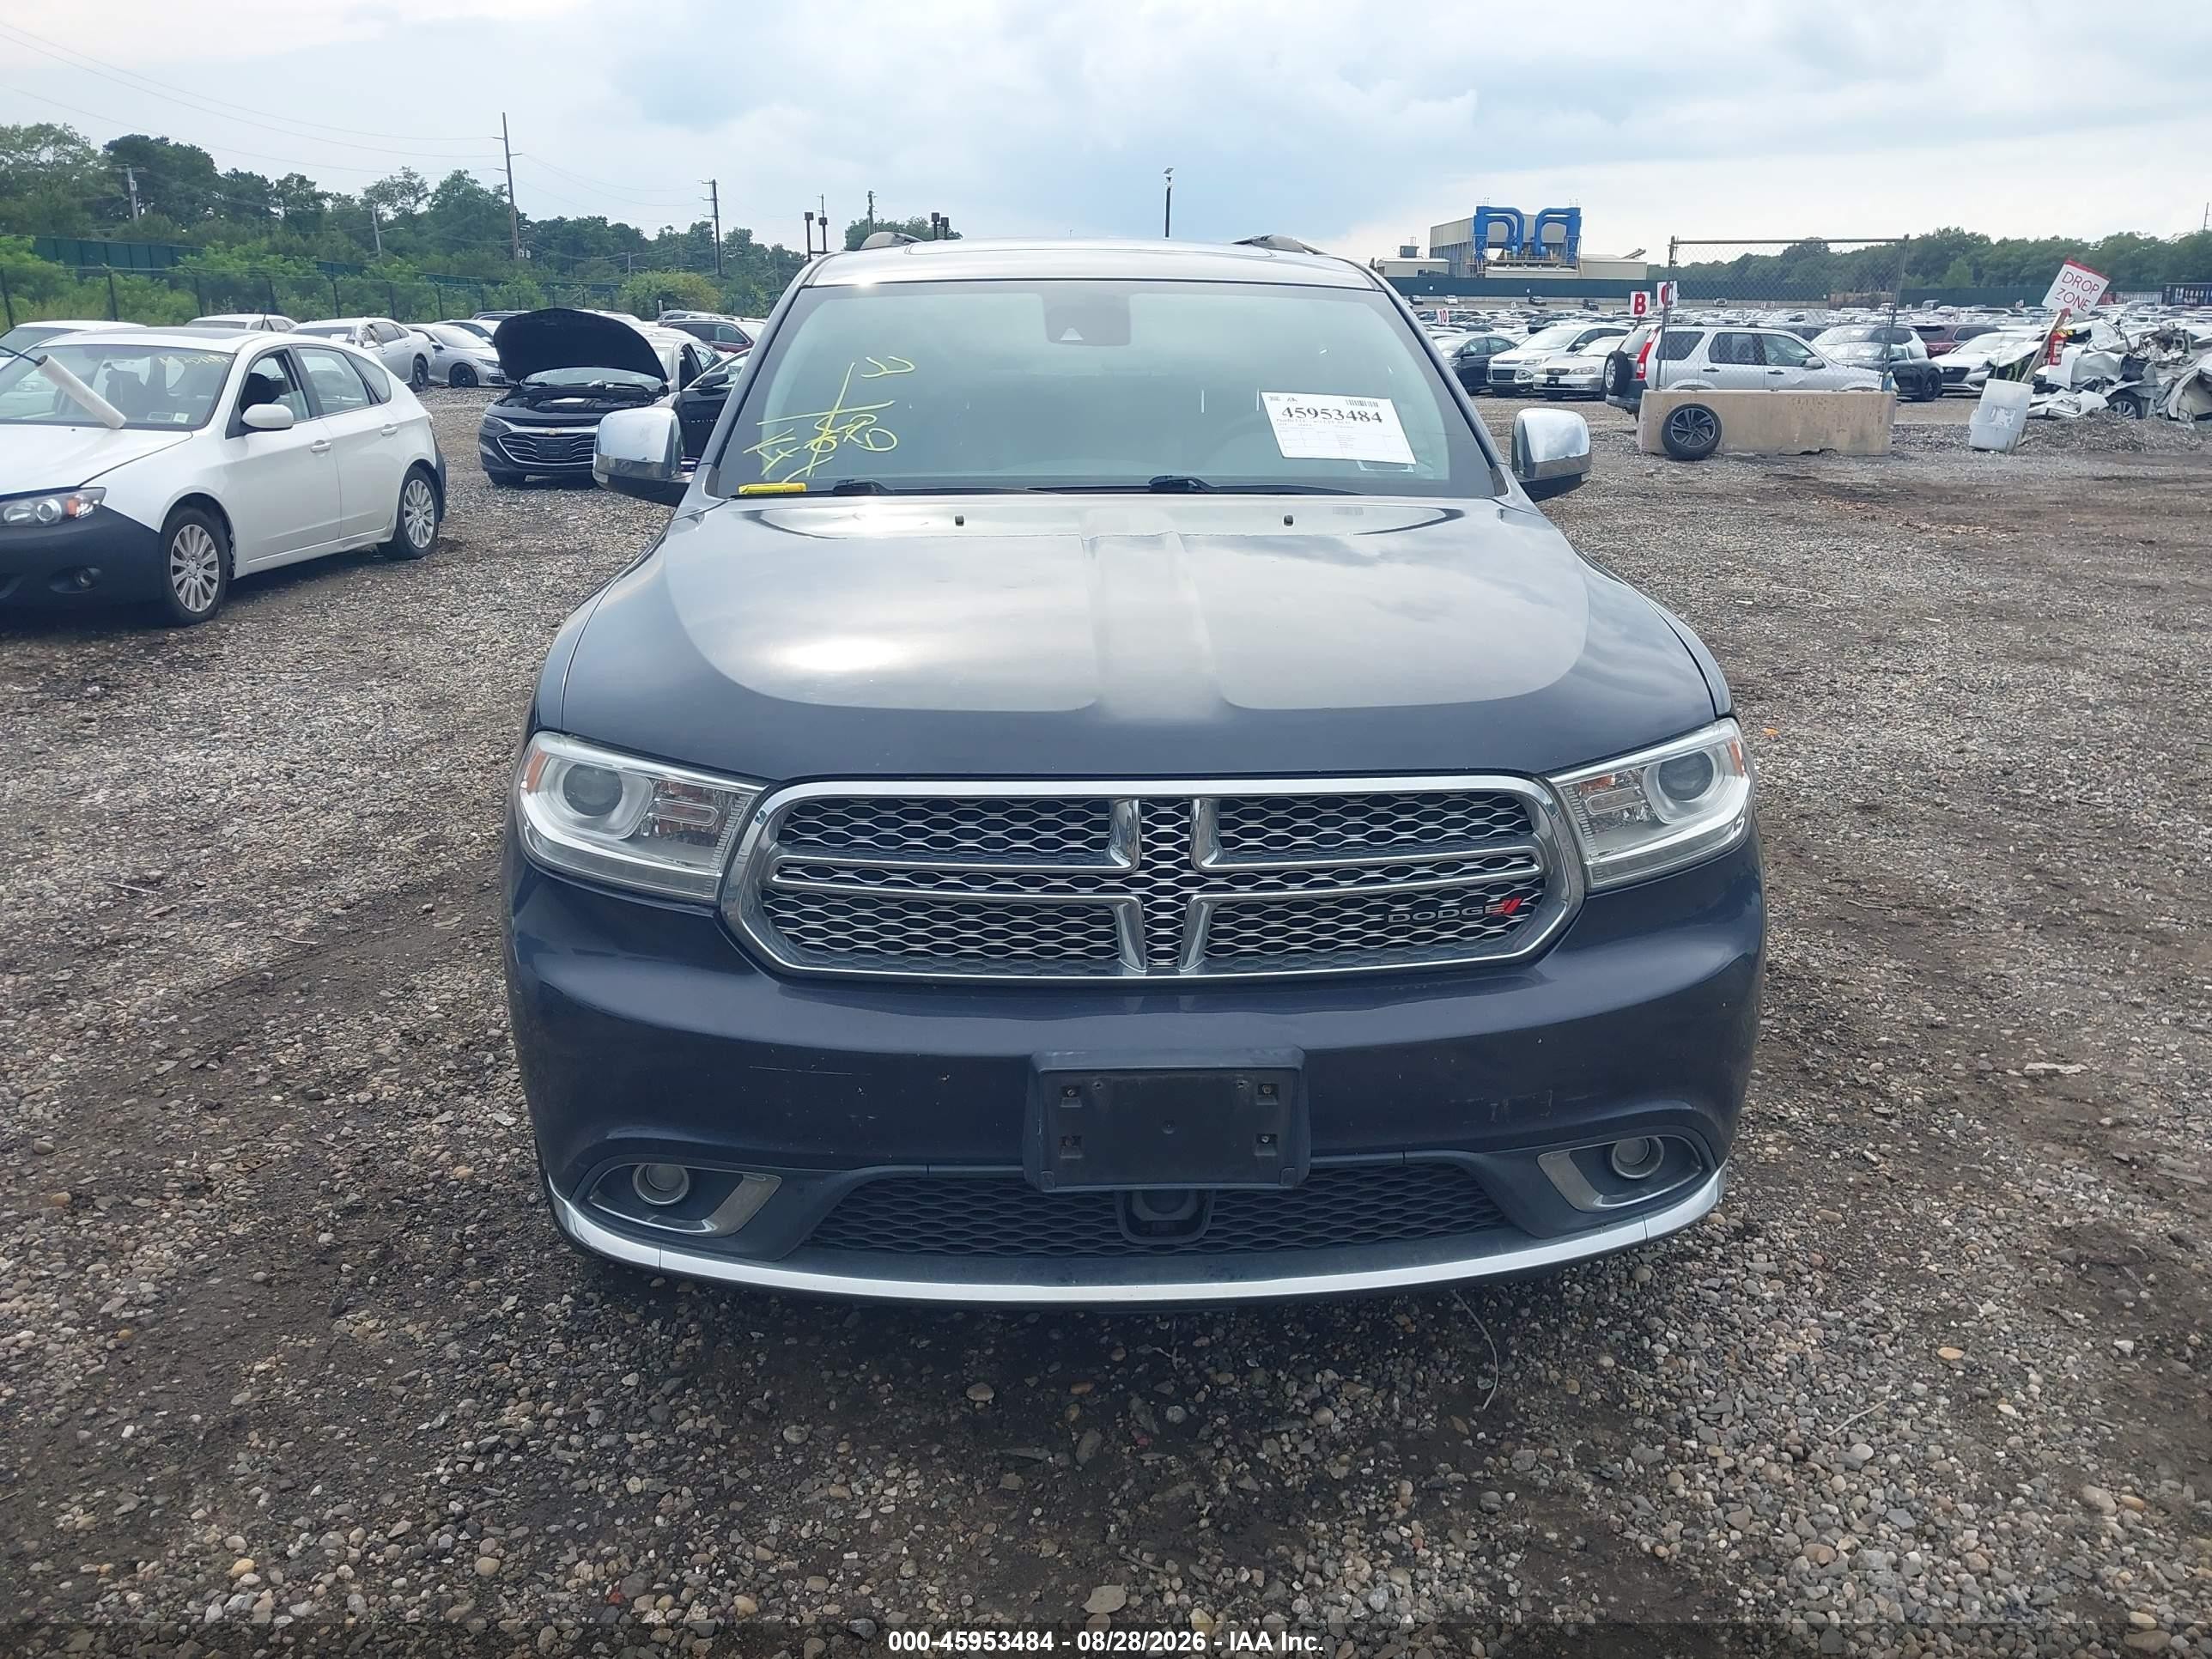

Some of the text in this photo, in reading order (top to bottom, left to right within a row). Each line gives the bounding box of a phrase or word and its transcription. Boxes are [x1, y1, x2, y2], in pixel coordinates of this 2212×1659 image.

[2062, 270, 2100, 295] DROP
[1633, 293, 1646, 315] B
[2055, 288, 2092, 312] ZONE
[1281, 406, 1383, 423] 45953484
[1388, 902, 1505, 923] DODGE
